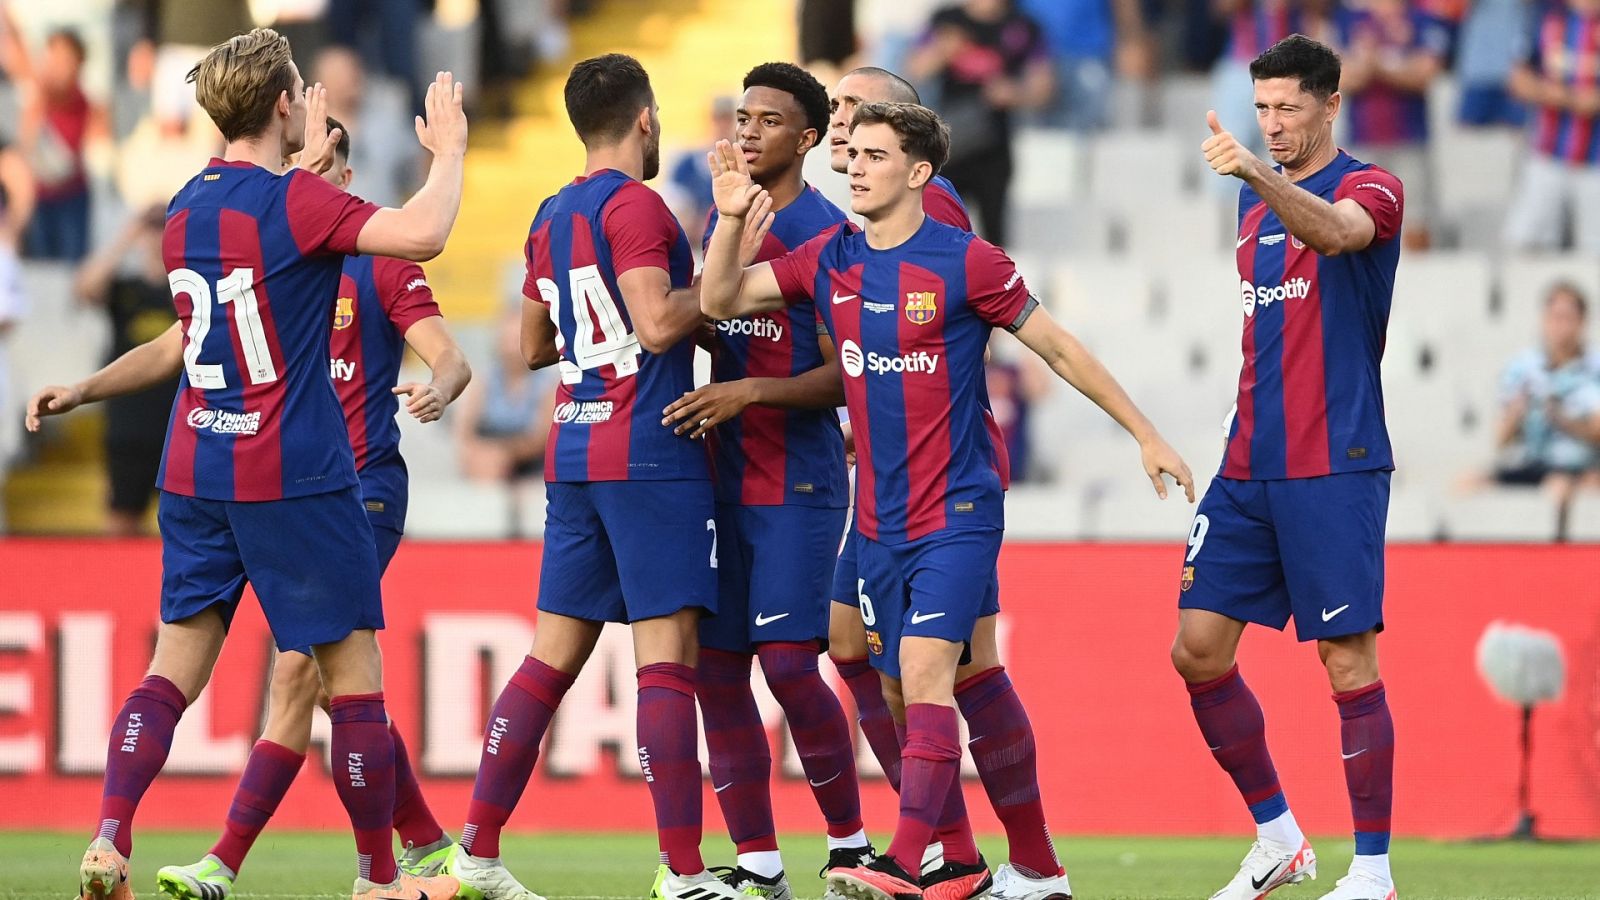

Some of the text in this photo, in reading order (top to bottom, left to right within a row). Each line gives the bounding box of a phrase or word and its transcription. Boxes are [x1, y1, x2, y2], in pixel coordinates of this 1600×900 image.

[1257, 277, 1311, 307] Spotify
[168, 268, 277, 389] 21
[717, 318, 783, 342] Spotify
[867, 351, 939, 376] Spotify
[217, 409, 261, 423] UNHCR
[575, 412, 611, 421] ACNUR
[581, 401, 614, 413] UNHCR
[212, 419, 259, 431] ACNUR
[1186, 514, 1210, 562] 9
[857, 577, 876, 626] 6
[121, 713, 143, 752] BARÇA
[487, 716, 509, 755] BARÇA
[348, 752, 366, 787] BARÇA
[638, 746, 654, 782] BARÇA
